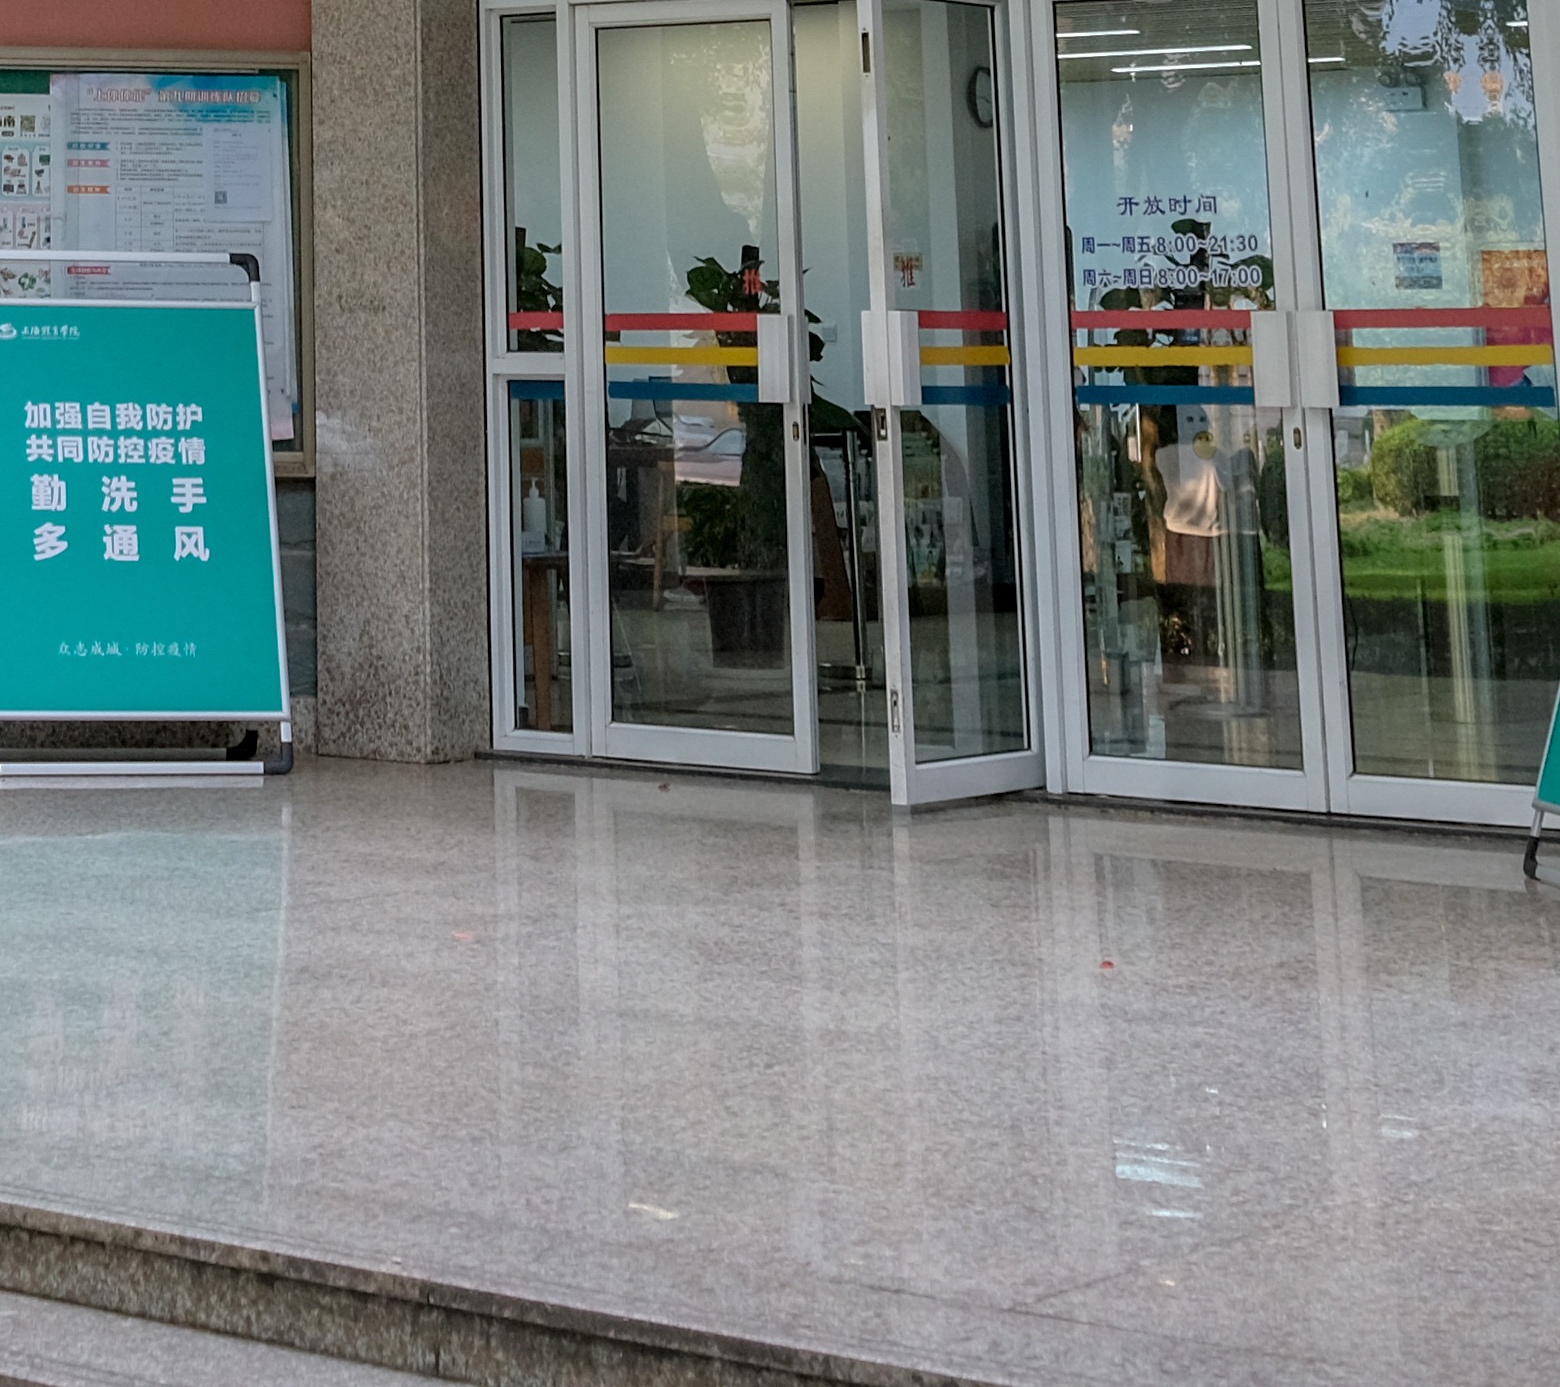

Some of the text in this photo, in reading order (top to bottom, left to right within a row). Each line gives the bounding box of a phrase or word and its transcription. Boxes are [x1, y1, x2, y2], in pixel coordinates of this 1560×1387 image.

[1116, 194, 1218, 216] 开放时间
[24, 400, 203, 431] 加强自我防护
[26, 434, 206, 465] 共同防控疫情
[30, 473, 208, 514] 勤洗手
[32, 522, 211, 562] 多通风
